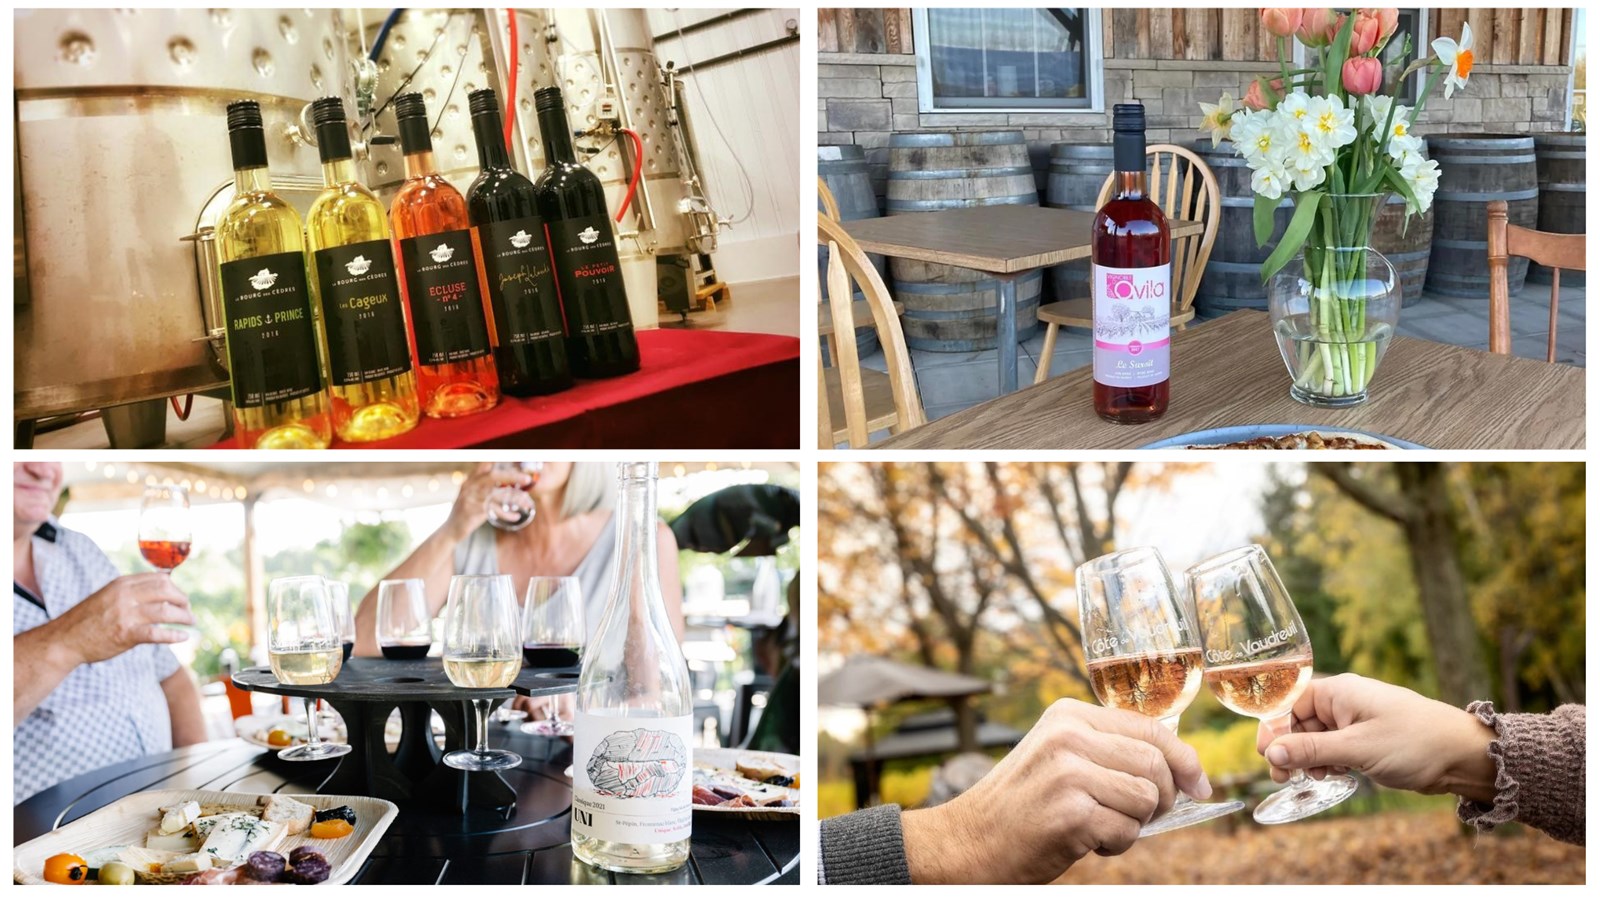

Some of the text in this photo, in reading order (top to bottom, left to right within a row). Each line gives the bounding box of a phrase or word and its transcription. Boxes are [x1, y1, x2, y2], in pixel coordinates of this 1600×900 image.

[421, 264, 442, 272] BOURG
[575, 264, 615, 278] POUVOIR
[337, 277, 358, 286] BOURG
[240, 292, 262, 301] BOURG
[349, 293, 388, 310] Cageux
[233, 307, 304, 331] RAPIDS PRINCE
[1206, 648, 1233, 663] Côte
[1240, 619, 1298, 655] Vaudreuil
[592, 801, 606, 810] 2021
[574, 806, 593, 828] UNI
